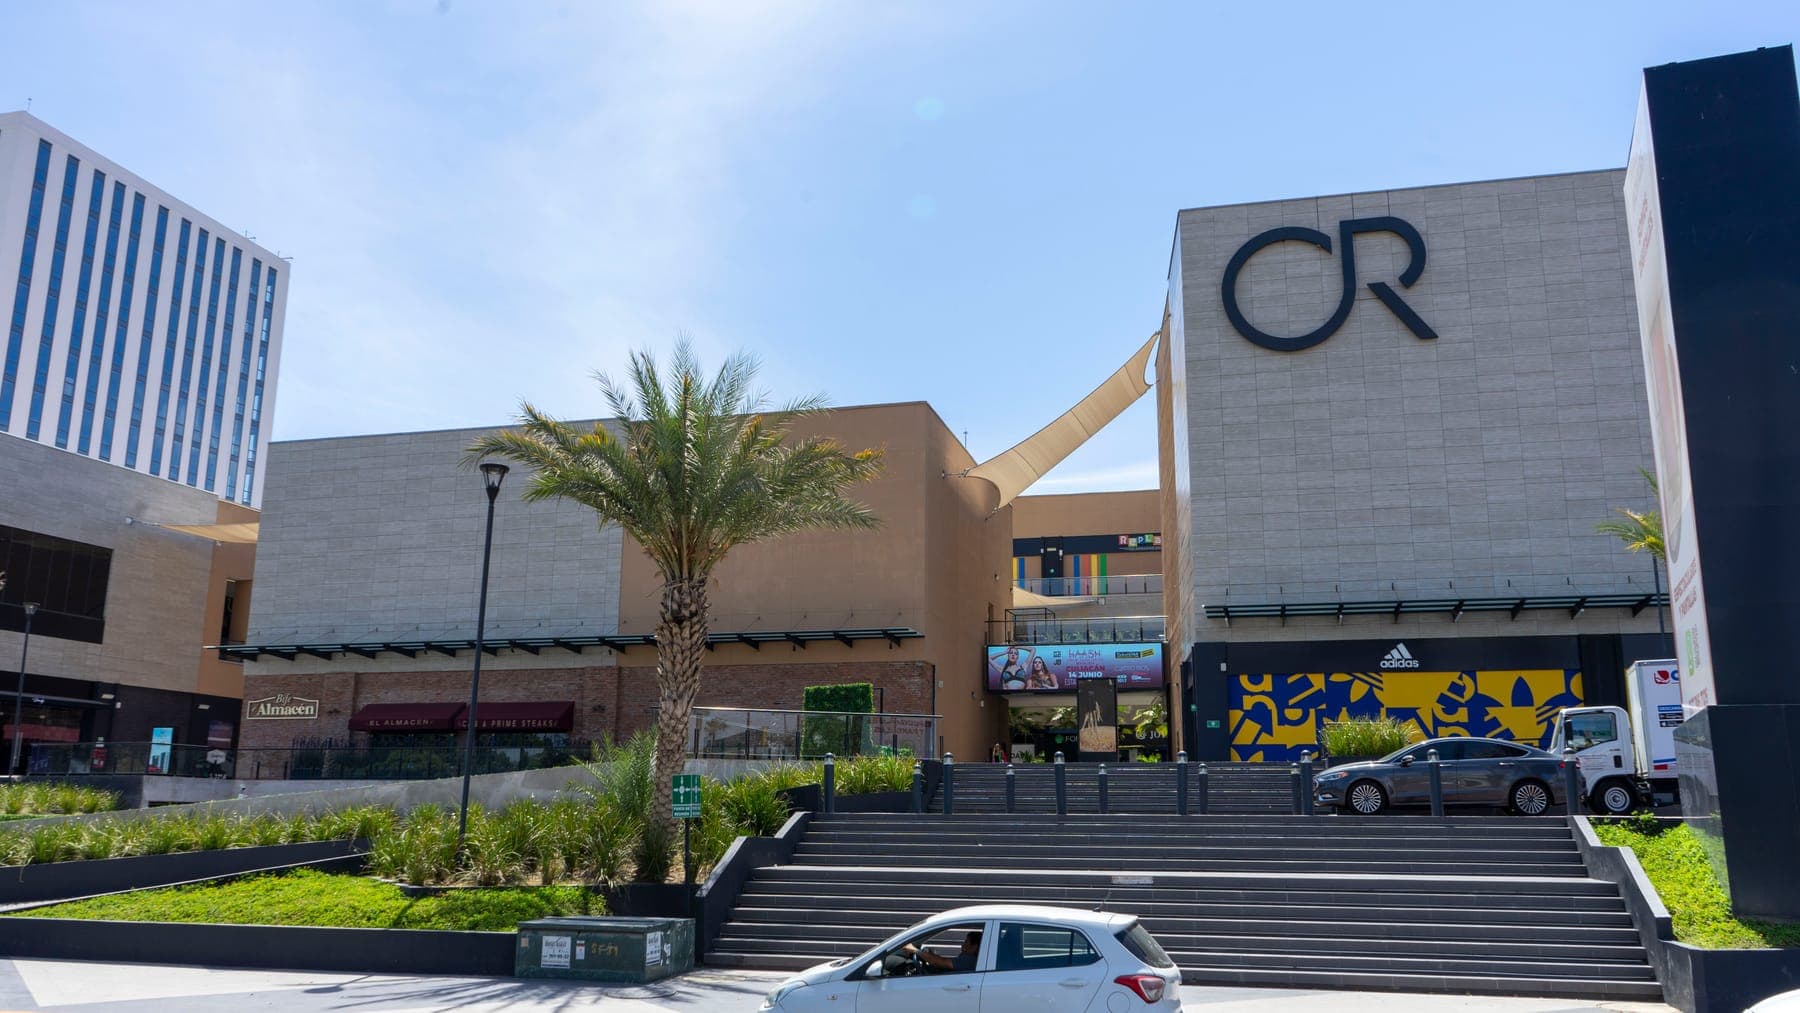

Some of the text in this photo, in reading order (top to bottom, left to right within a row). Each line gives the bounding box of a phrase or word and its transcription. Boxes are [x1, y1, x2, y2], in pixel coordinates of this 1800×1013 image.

[1380, 658, 1419, 668] adidas
[257, 703, 314, 716] Almacén
[491, 720, 517, 728] PRIME
[521, 720, 554, 728] STEAKS
